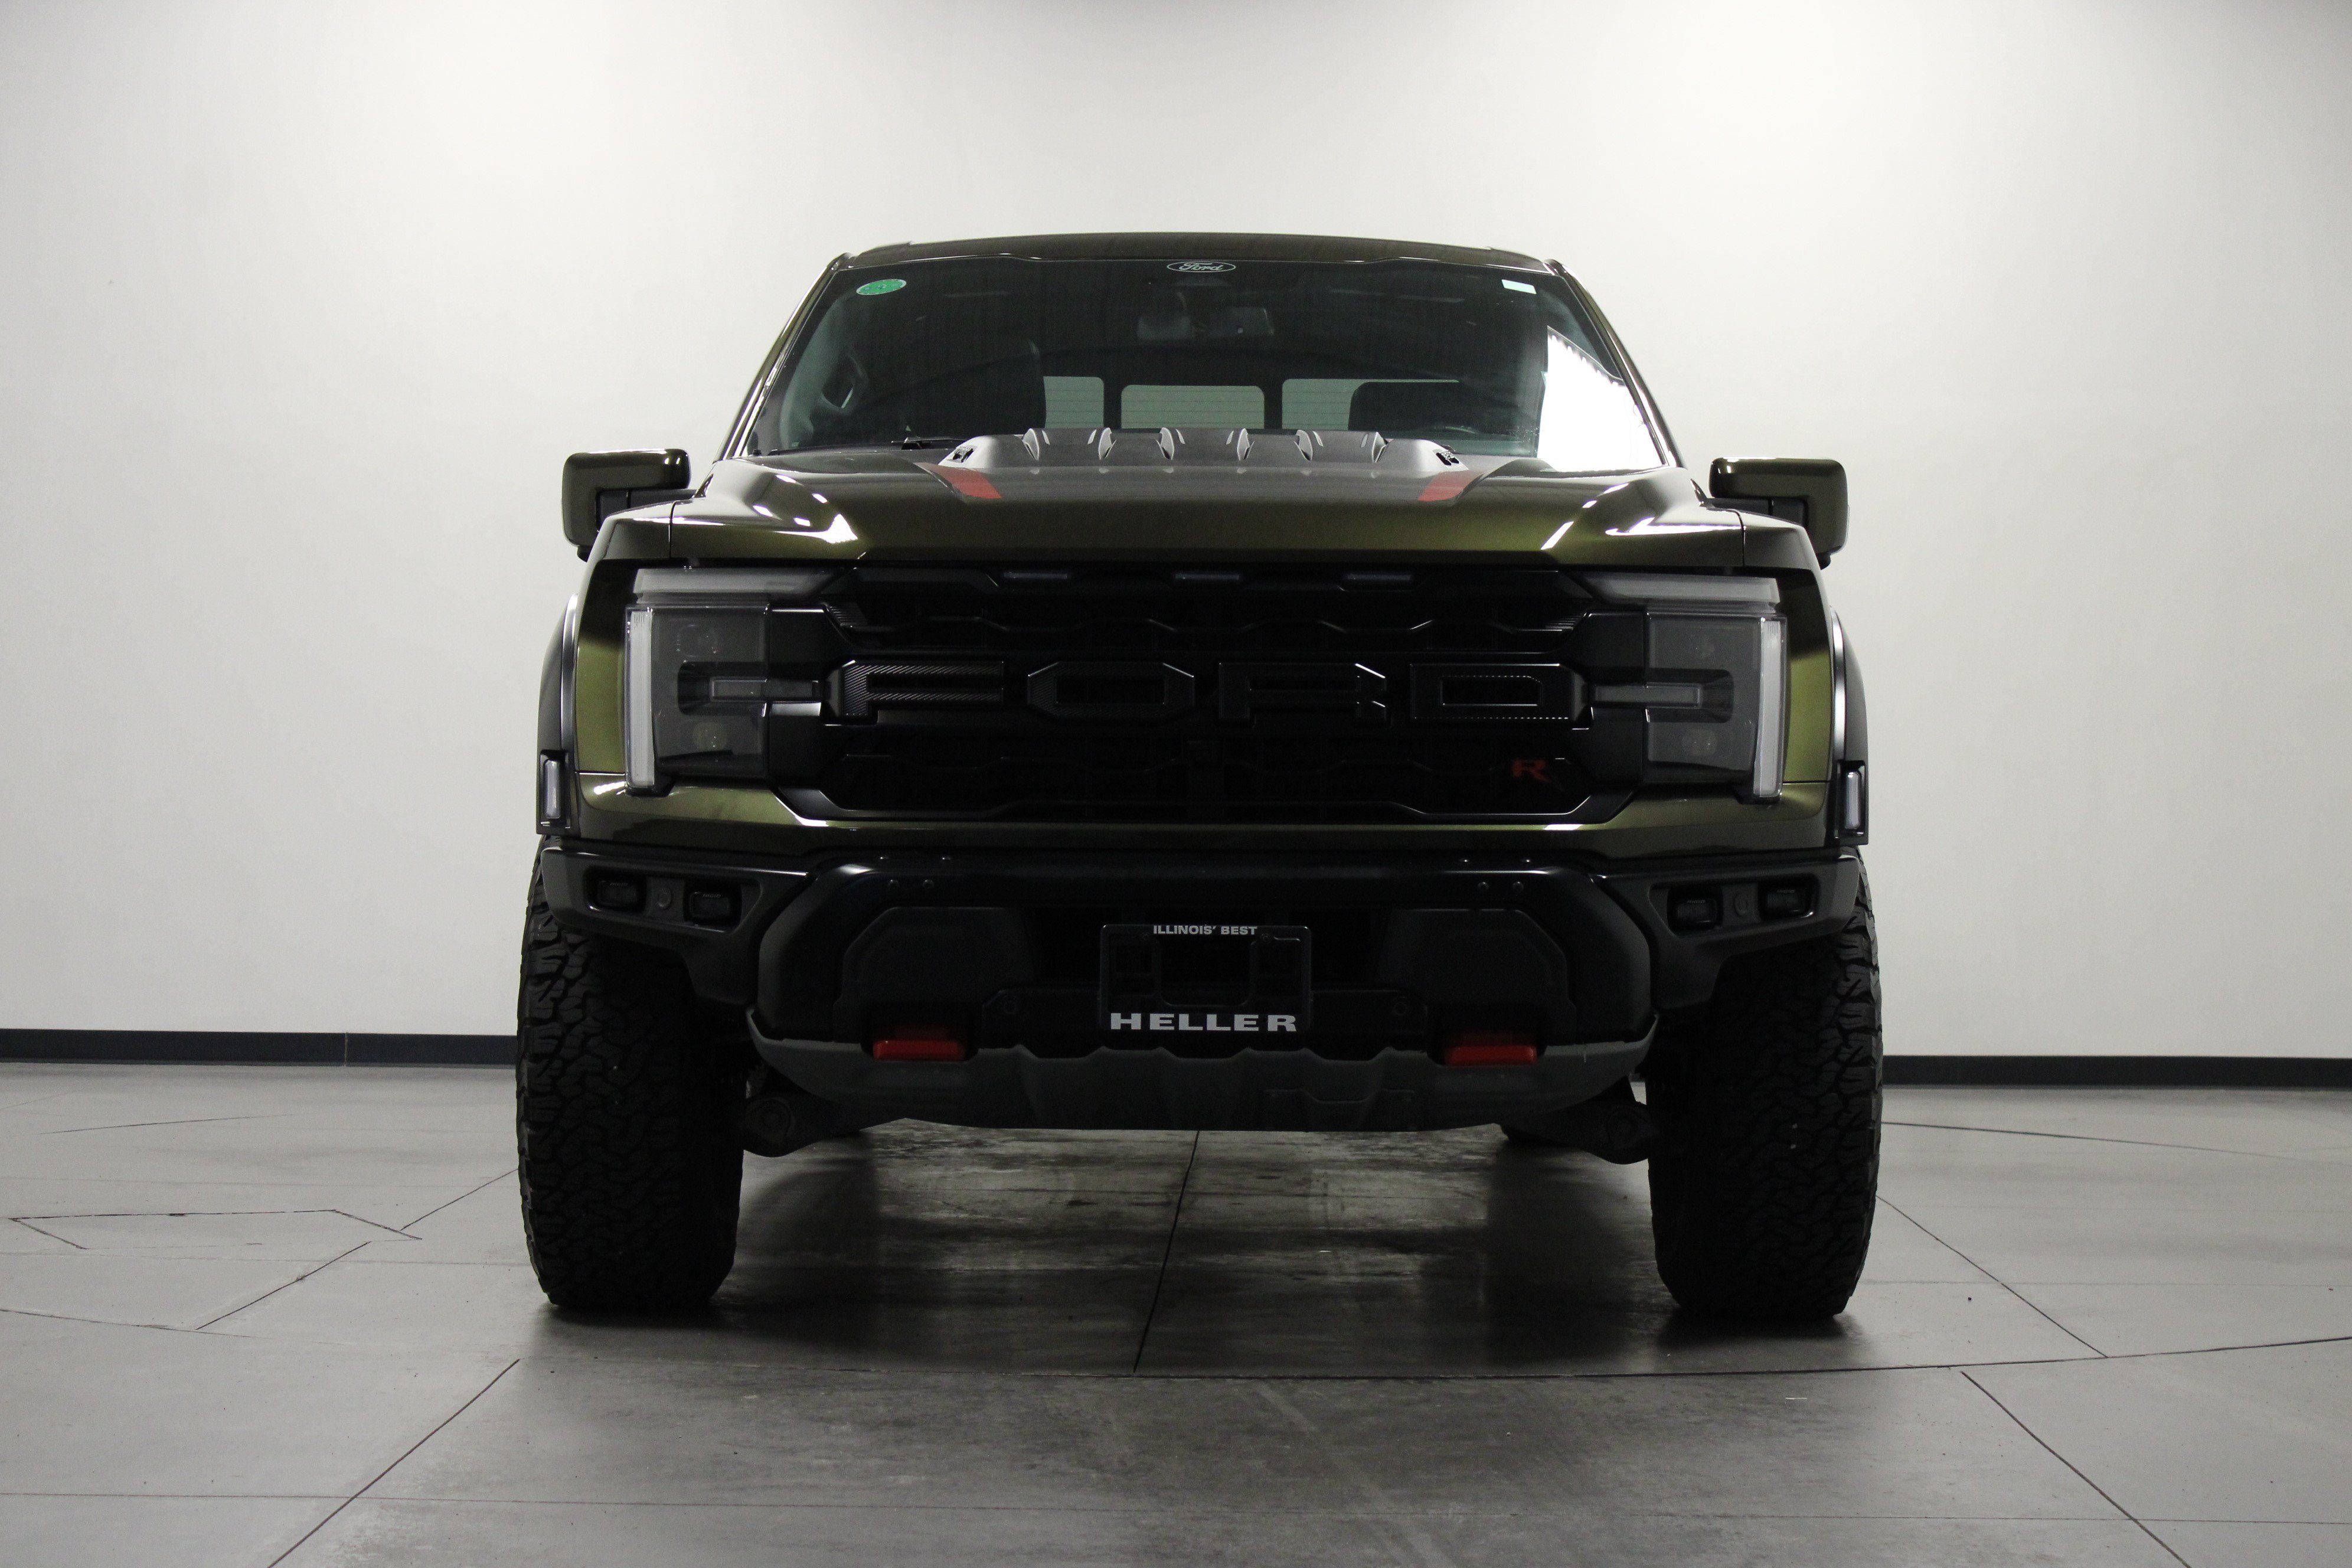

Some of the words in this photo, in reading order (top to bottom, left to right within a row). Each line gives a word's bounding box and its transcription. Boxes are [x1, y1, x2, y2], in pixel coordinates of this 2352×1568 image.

[1179, 262, 1224, 270] Ford
[825, 658, 1588, 722] FORD
[1511, 758, 1551, 784] R
[1153, 925, 1216, 935] ILLINOIS'
[1220, 926, 1257, 935] BEST
[1110, 1012, 1296, 1032] HELLER
